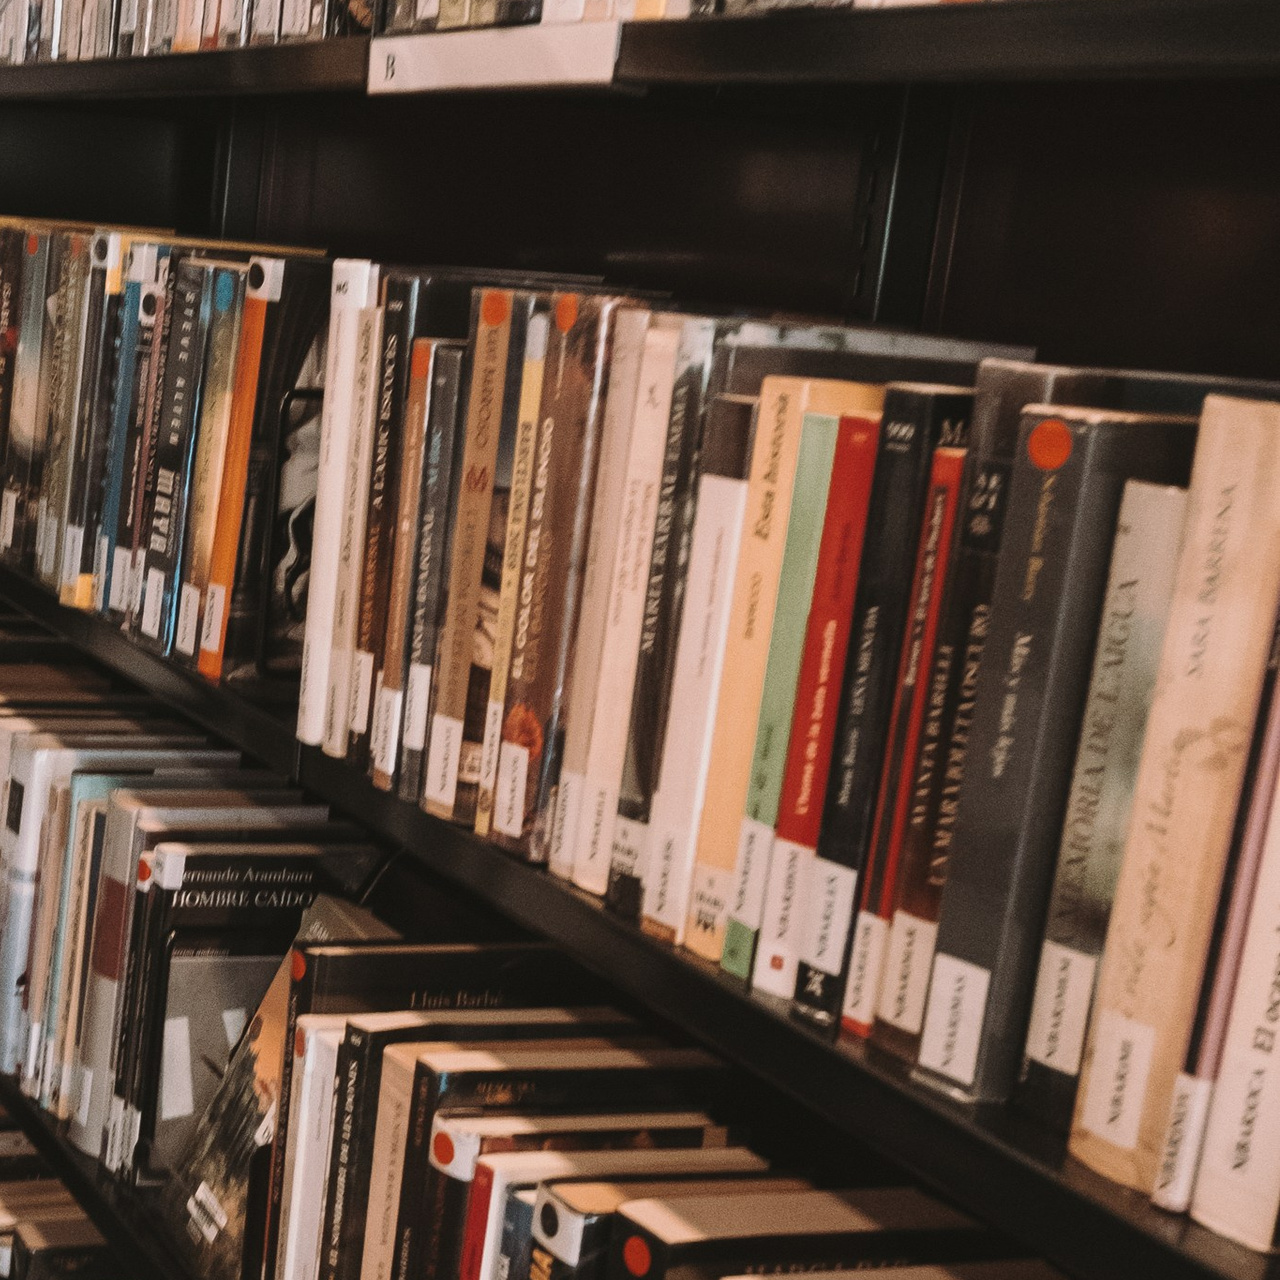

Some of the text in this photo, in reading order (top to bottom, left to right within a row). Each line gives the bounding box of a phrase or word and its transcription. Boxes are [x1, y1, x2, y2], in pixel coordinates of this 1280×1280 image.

[383, 53, 396, 82] B
[166, 291, 195, 447] STEVE ALTEN
[377, 332, 399, 420] ESCOCÈS
[530, 415, 556, 522] SILENCIO
[524, 525, 542, 568] DEL
[1196, 480, 1240, 607] BARRENA
[514, 570, 536, 652] COLOR
[1182, 611, 1215, 681] SARA
[1053, 573, 1141, 922] MEMÒRIA DE L'AIGUA
[171, 889, 313, 909] HOMBRE CAÍDO
[181, 867, 314, 883] ernando Aramburu
